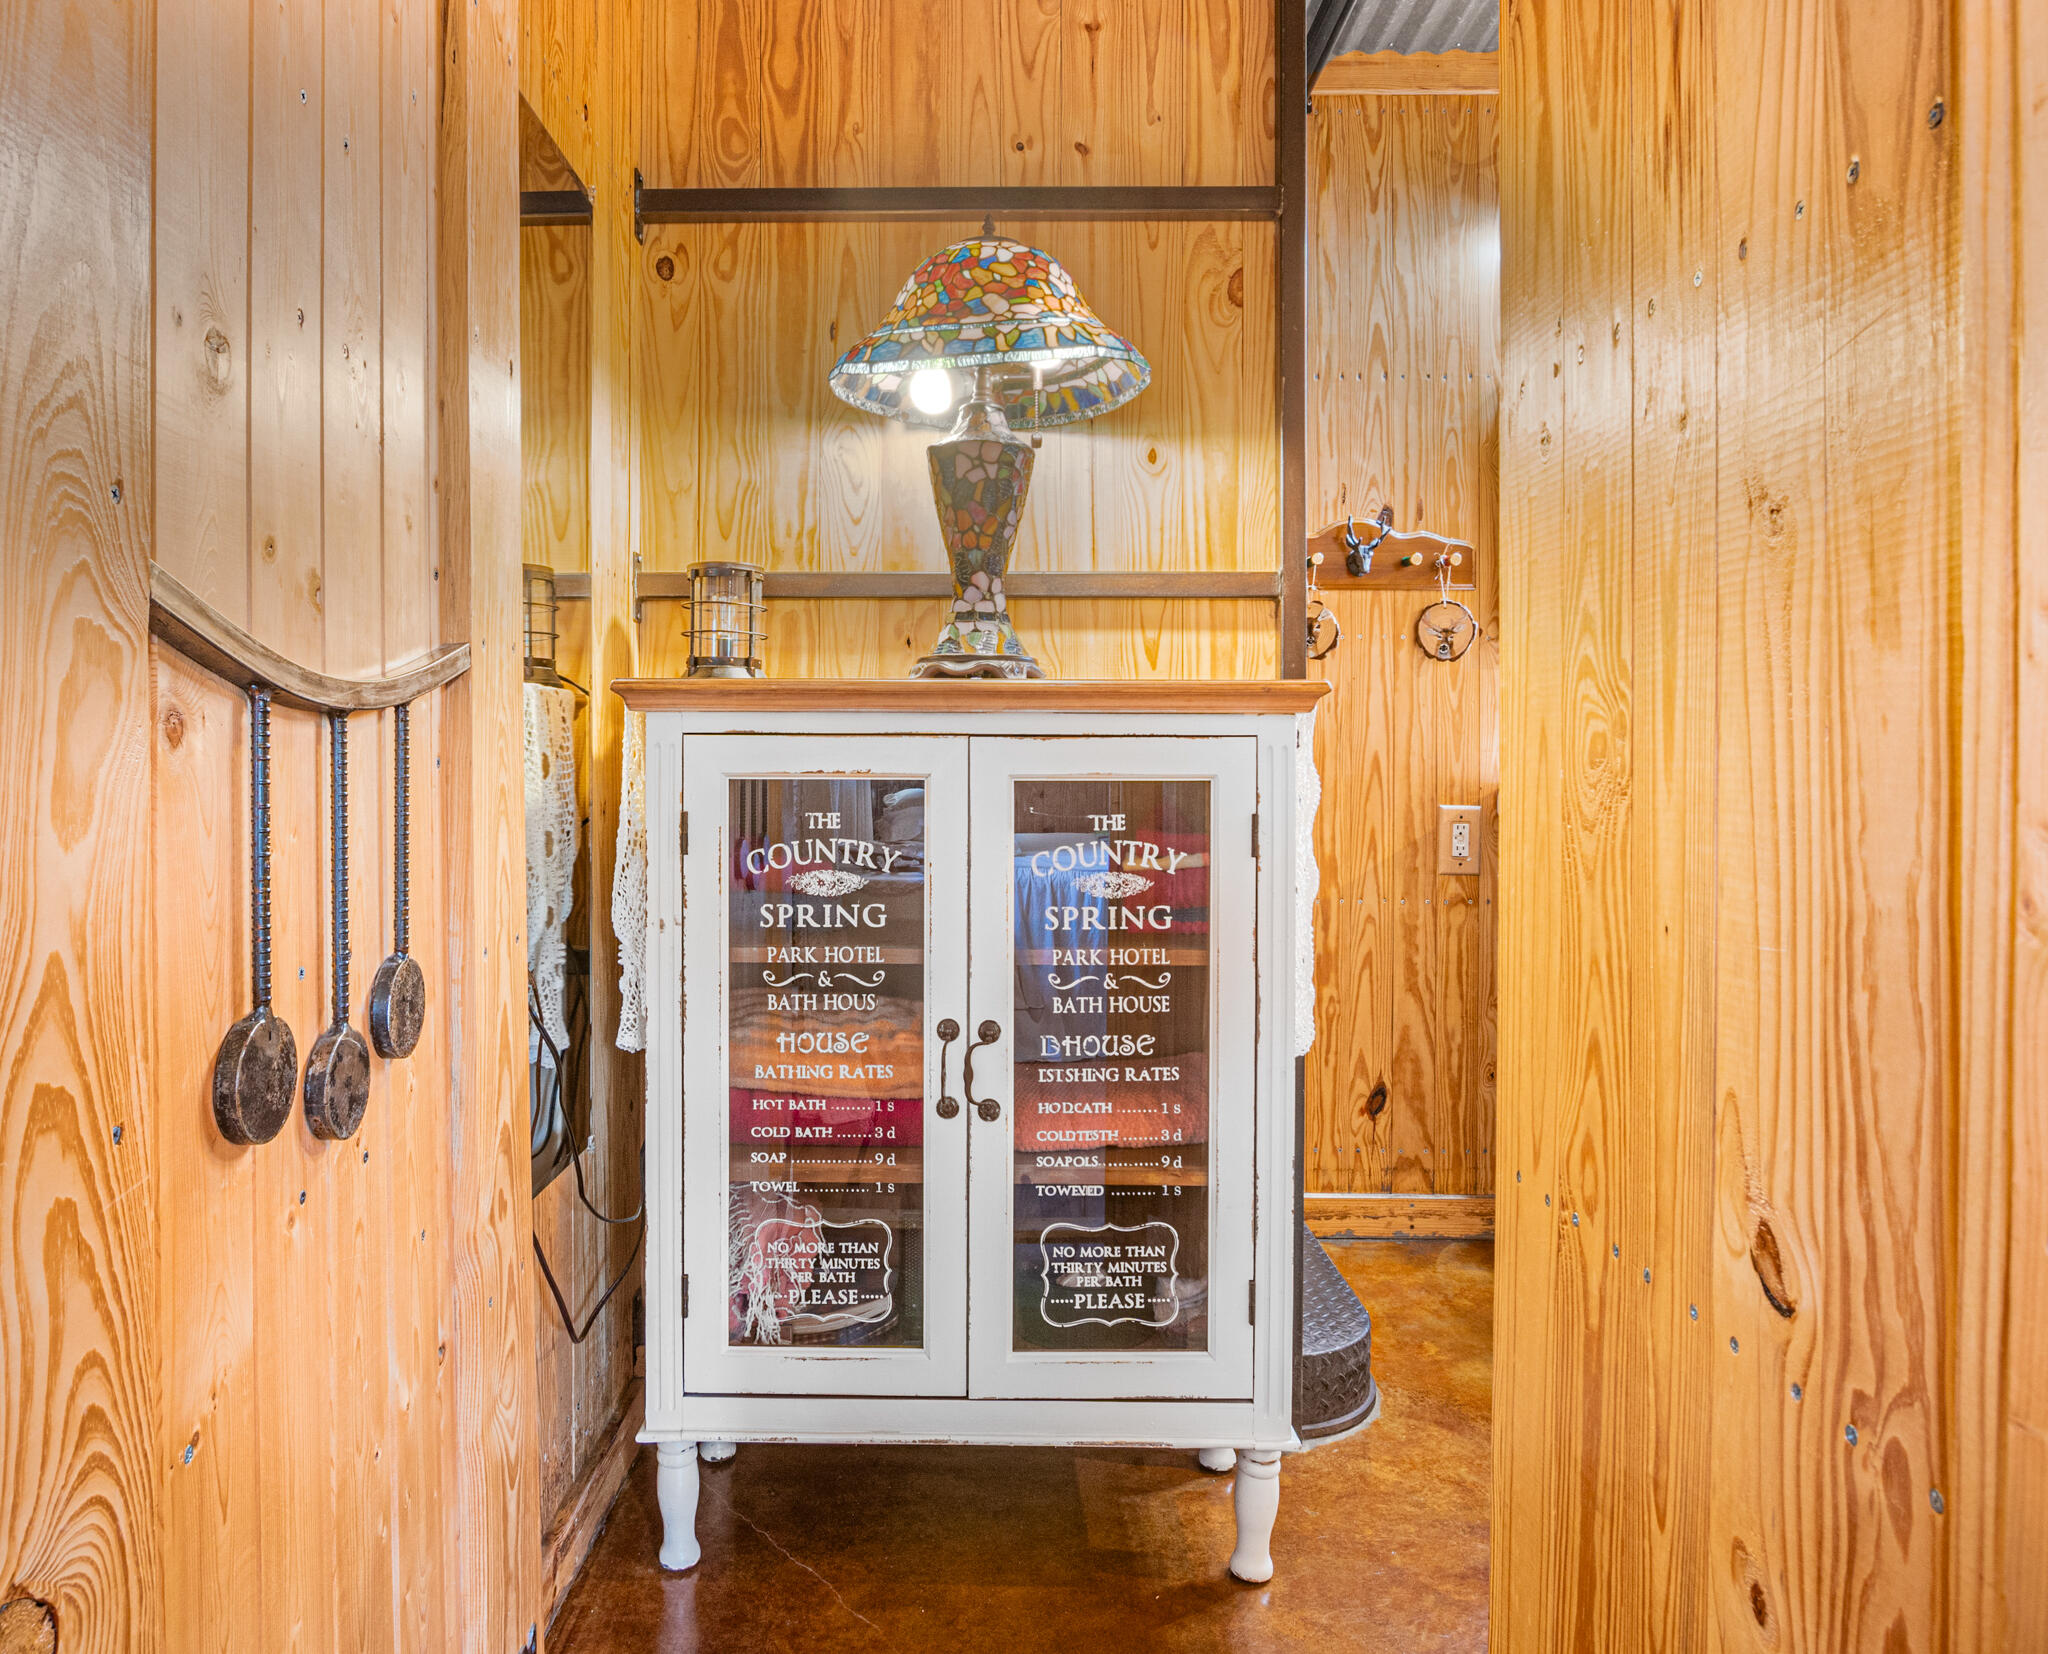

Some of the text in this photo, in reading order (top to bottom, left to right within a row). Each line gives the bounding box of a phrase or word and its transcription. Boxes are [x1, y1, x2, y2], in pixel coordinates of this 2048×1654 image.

[805, 812, 841, 829] THE
[1088, 814, 1126, 831] THE
[746, 838, 902, 875] COUNTRY
[1031, 840, 1188, 877] COUNTRY
[759, 903, 887, 928] SPRING
[1044, 905, 1173, 931] SPRING
[767, 946, 885, 963] PARK HOTEL
[1052, 948, 1171, 966] PARK HOTEL
[817, 970, 833, 987] &
[1103, 973, 1119, 990] &
[767, 993, 817, 1011] BATH
[1052, 995, 1170, 1014] BATH HOUSE
[776, 1032, 870, 1054] HOUSE
[754, 1064, 894, 1080] BATHING RATES
[1125, 1067, 1180, 1082] RATES
[752, 1099, 784, 1111] HOT
[788, 1099, 826, 1111] BATH
[875, 1100, 882, 1111] 1
[1162, 1103, 1169, 1114] 1
[750, 1126, 896, 1139] COLD BATH 3 d
[1161, 1129, 1170, 1142] 3
[1173, 1129, 1182, 1142] d
[750, 1152, 897, 1166] SOAP 9 d
[1161, 1157, 1170, 1169] 9
[1173, 1157, 1183, 1169] d
[750, 1181, 800, 1192] TOWEL
[875, 1182, 883, 1193] 1
[1162, 1186, 1169, 1196] 1
[767, 1242, 879, 1254] NO MORE THAN
[1052, 1246, 1166, 1258] NO MORE THAN
[765, 1258, 881, 1270] THIRTY MINUTES
[1051, 1262, 1167, 1274] THIRTY MINUTES
[790, 1272, 856, 1284] PER BATH
[1076, 1275, 1142, 1287] PER BATH
[788, 1289, 859, 1305] PLEASE
[1073, 1293, 1145, 1310] PLEASE
